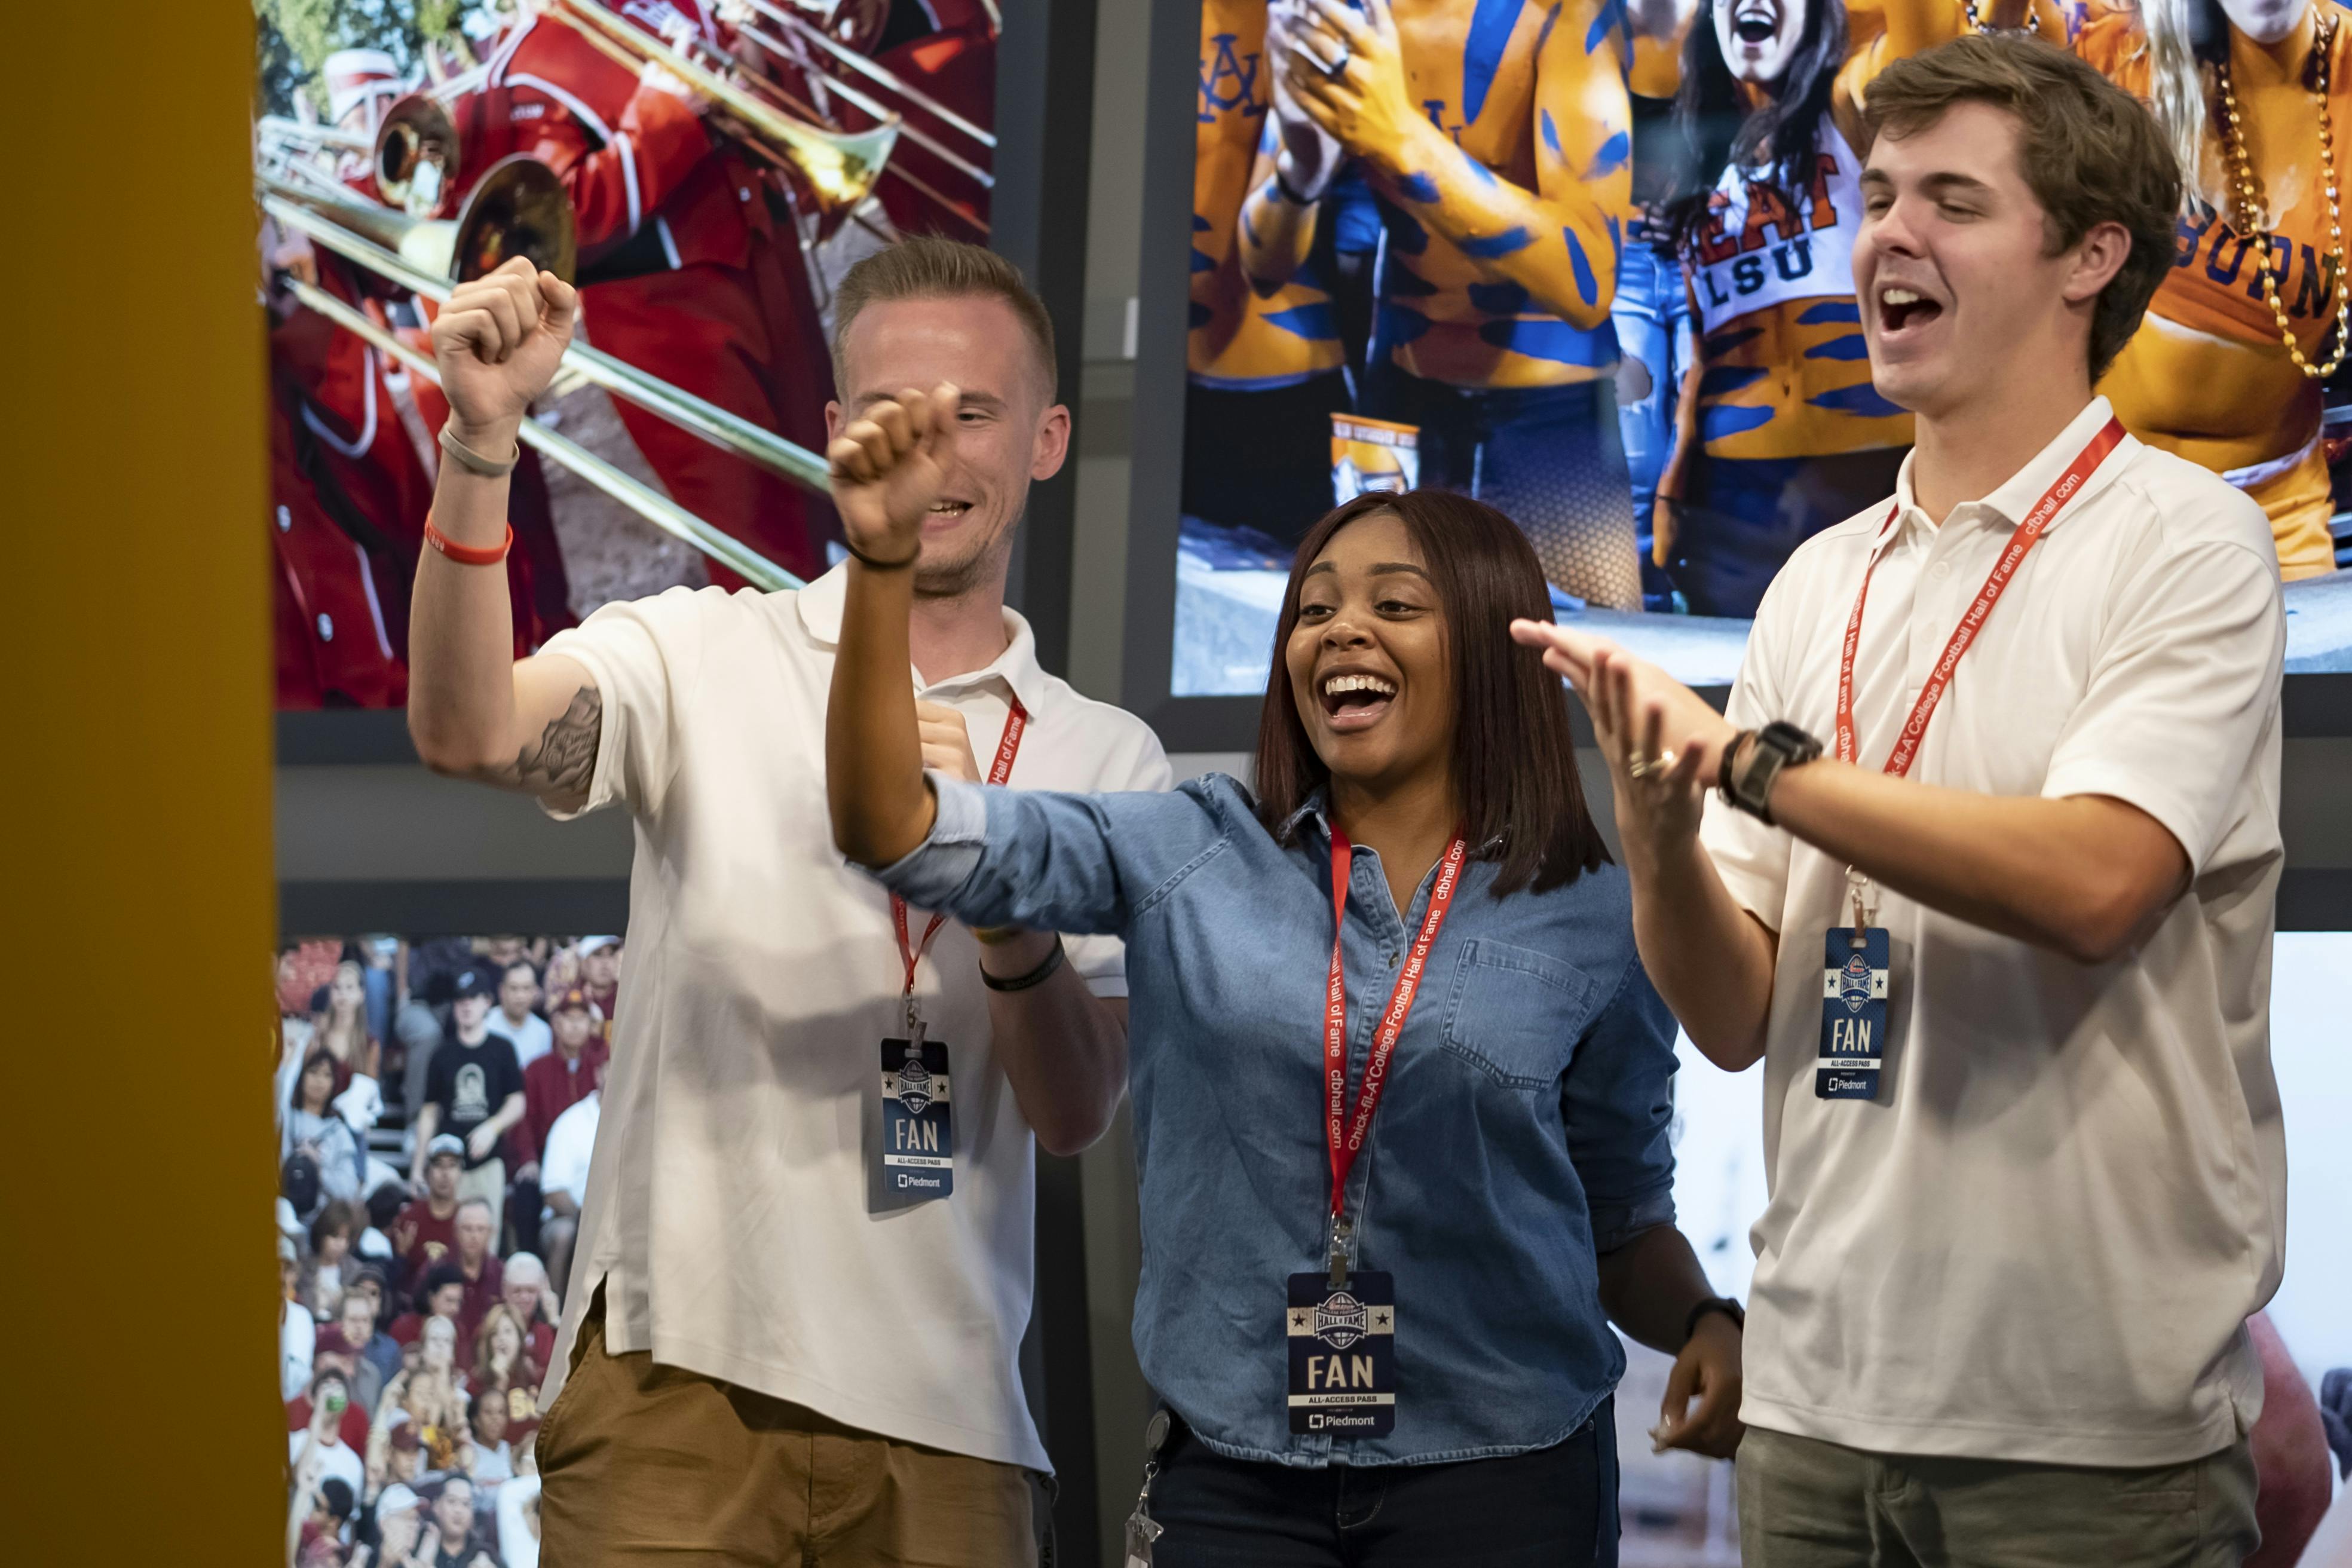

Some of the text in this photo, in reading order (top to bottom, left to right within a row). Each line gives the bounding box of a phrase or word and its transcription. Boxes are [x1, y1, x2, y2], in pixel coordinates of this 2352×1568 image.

[1704, 237, 1813, 308] LSU
[1908, 683, 1940, 735] College
[1934, 627, 1971, 681] Football
[1965, 598, 1989, 626] Hall
[1986, 582, 1999, 598] of
[1993, 544, 2023, 582] Fame
[2025, 473, 2080, 535] cfbhall.com
[1845, 632, 1857, 657] Hall
[1839, 675, 1850, 714] Fame
[992, 716, 1021, 783] Hall of Fame
[1437, 840, 1465, 900] cfbhall.com
[1420, 909, 1441, 942] Fame
[1417, 944, 1428, 956] of
[1405, 957, 1422, 979] Hall
[1331, 976, 1342, 1002] Hall
[1386, 979, 1414, 1027] Football
[1331, 1004, 1343, 1016] of
[1330, 1019, 1343, 1058] Fame
[1832, 1018, 1872, 1053] FAN
[1370, 1028, 1395, 1077] College
[901, 1079, 913, 1093] HALL
[917, 1081, 930, 1095] FAME
[1838, 1079, 1866, 1089] Piedmont
[1331, 1070, 1344, 1149] cfbhall.com
[895, 1119, 938, 1152] FAN
[908, 1176, 940, 1187] Piedmont
[1318, 1312, 1364, 1328] HALL FAME
[1308, 1355, 1373, 1389] FAN
[1326, 1415, 1374, 1426] Piedmont
